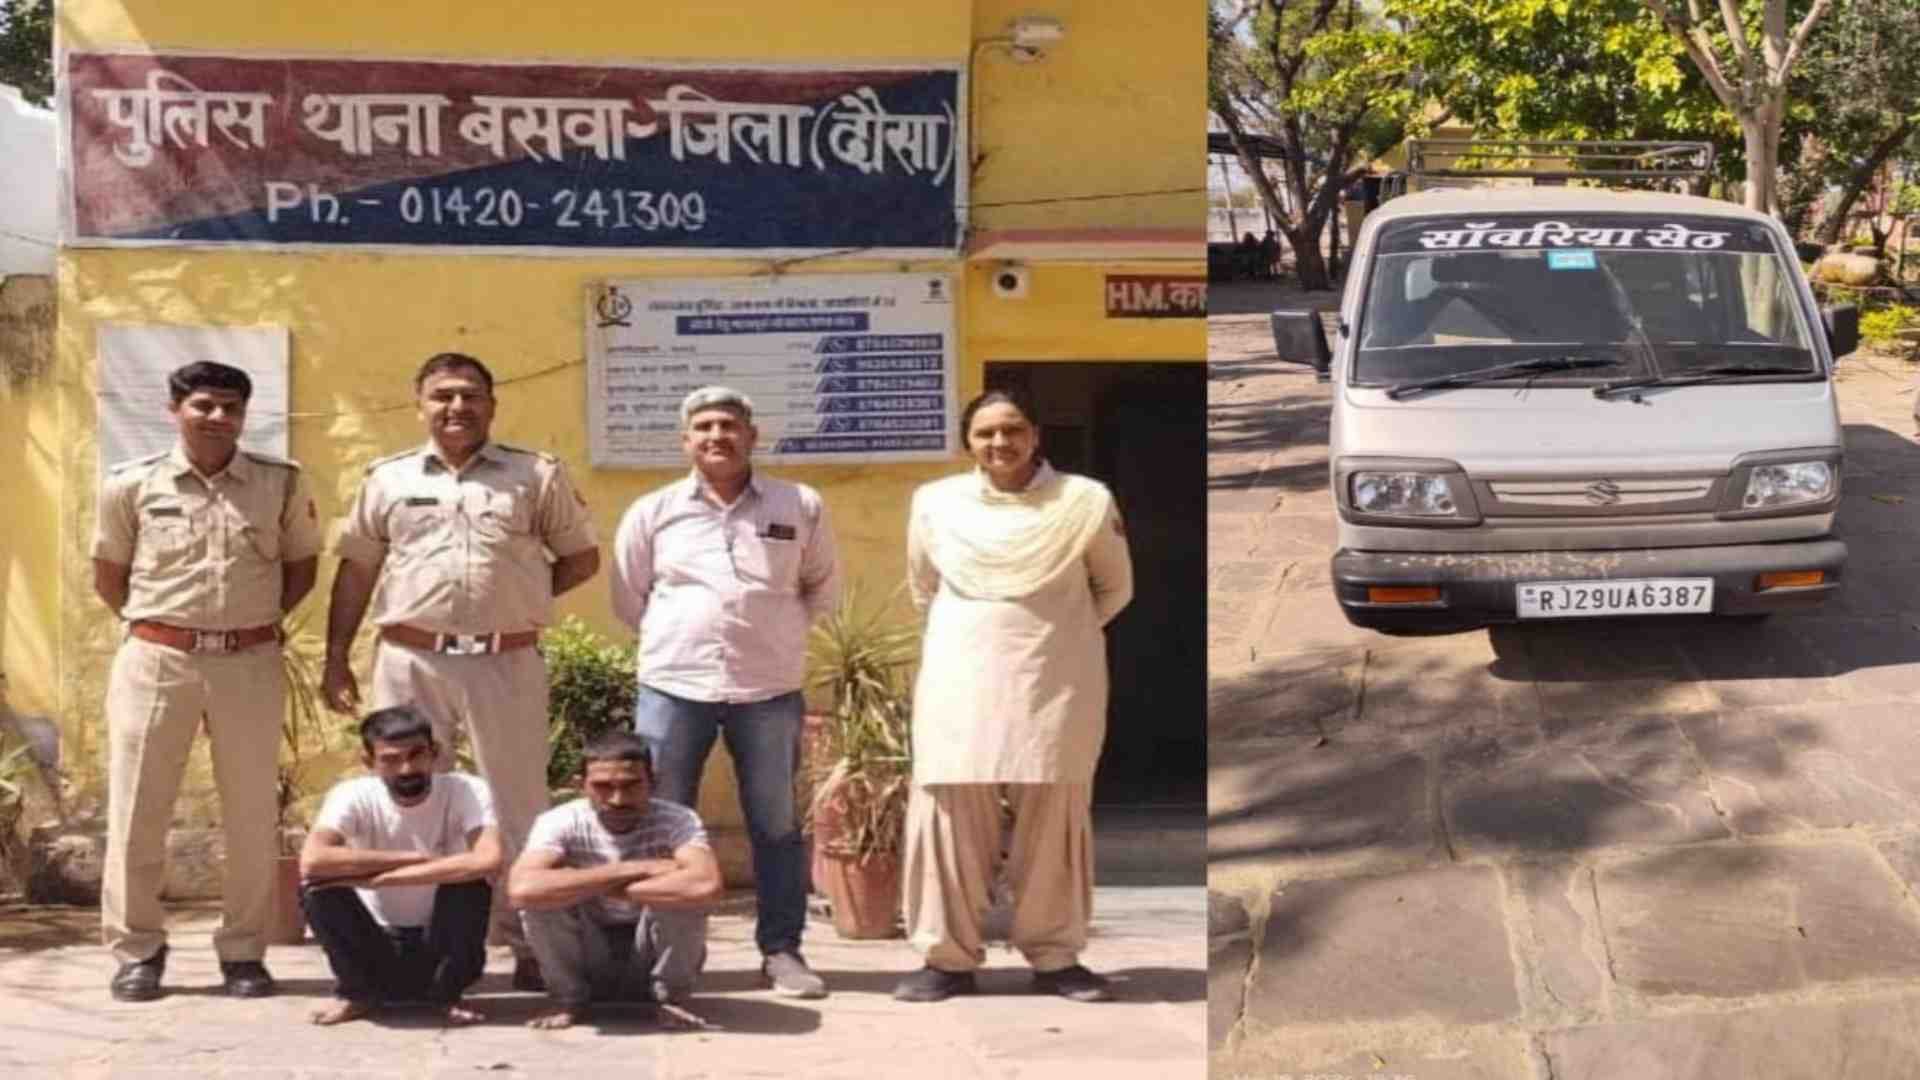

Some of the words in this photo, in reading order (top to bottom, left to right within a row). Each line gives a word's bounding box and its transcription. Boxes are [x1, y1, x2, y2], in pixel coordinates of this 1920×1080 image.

[93, 69, 271, 167] पुलिस
[302, 94, 450, 156] थाना
[1646, 224, 1732, 248] सेठ
[1540, 586, 1707, 611] RJ29UA6387
